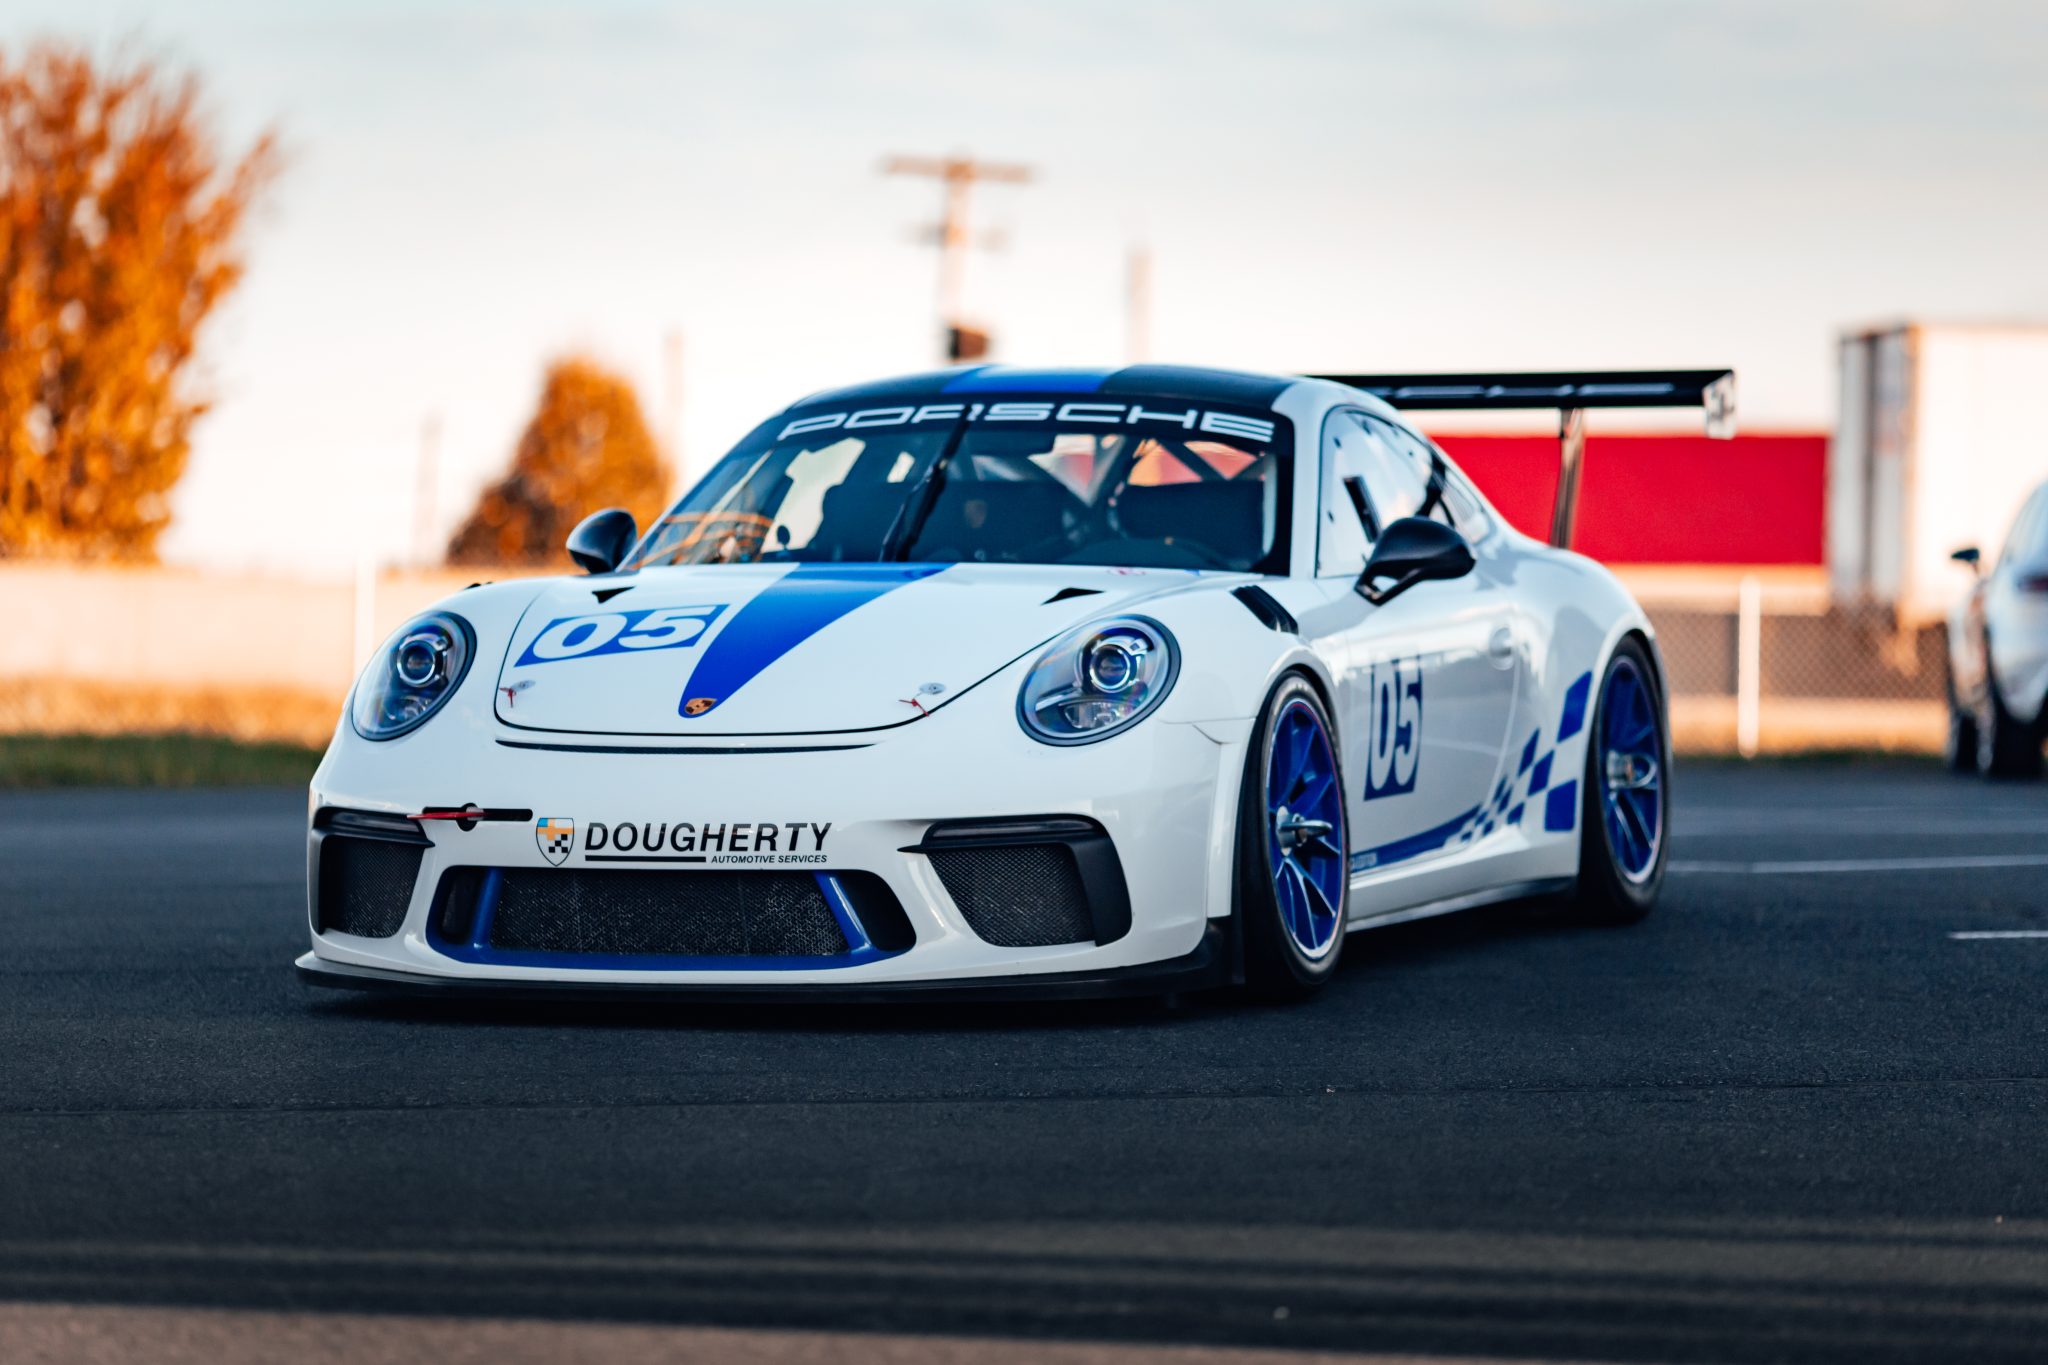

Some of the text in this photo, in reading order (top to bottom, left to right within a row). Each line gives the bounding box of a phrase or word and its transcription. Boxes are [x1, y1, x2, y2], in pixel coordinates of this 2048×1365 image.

[776, 401, 1275, 443] PORSCHE
[532, 605, 707, 660] 05
[1369, 662, 1421, 790] 05
[584, 822, 832, 852] DOUGHERTY
[711, 855, 828, 863] AUTOMOTIVE SERVICES
